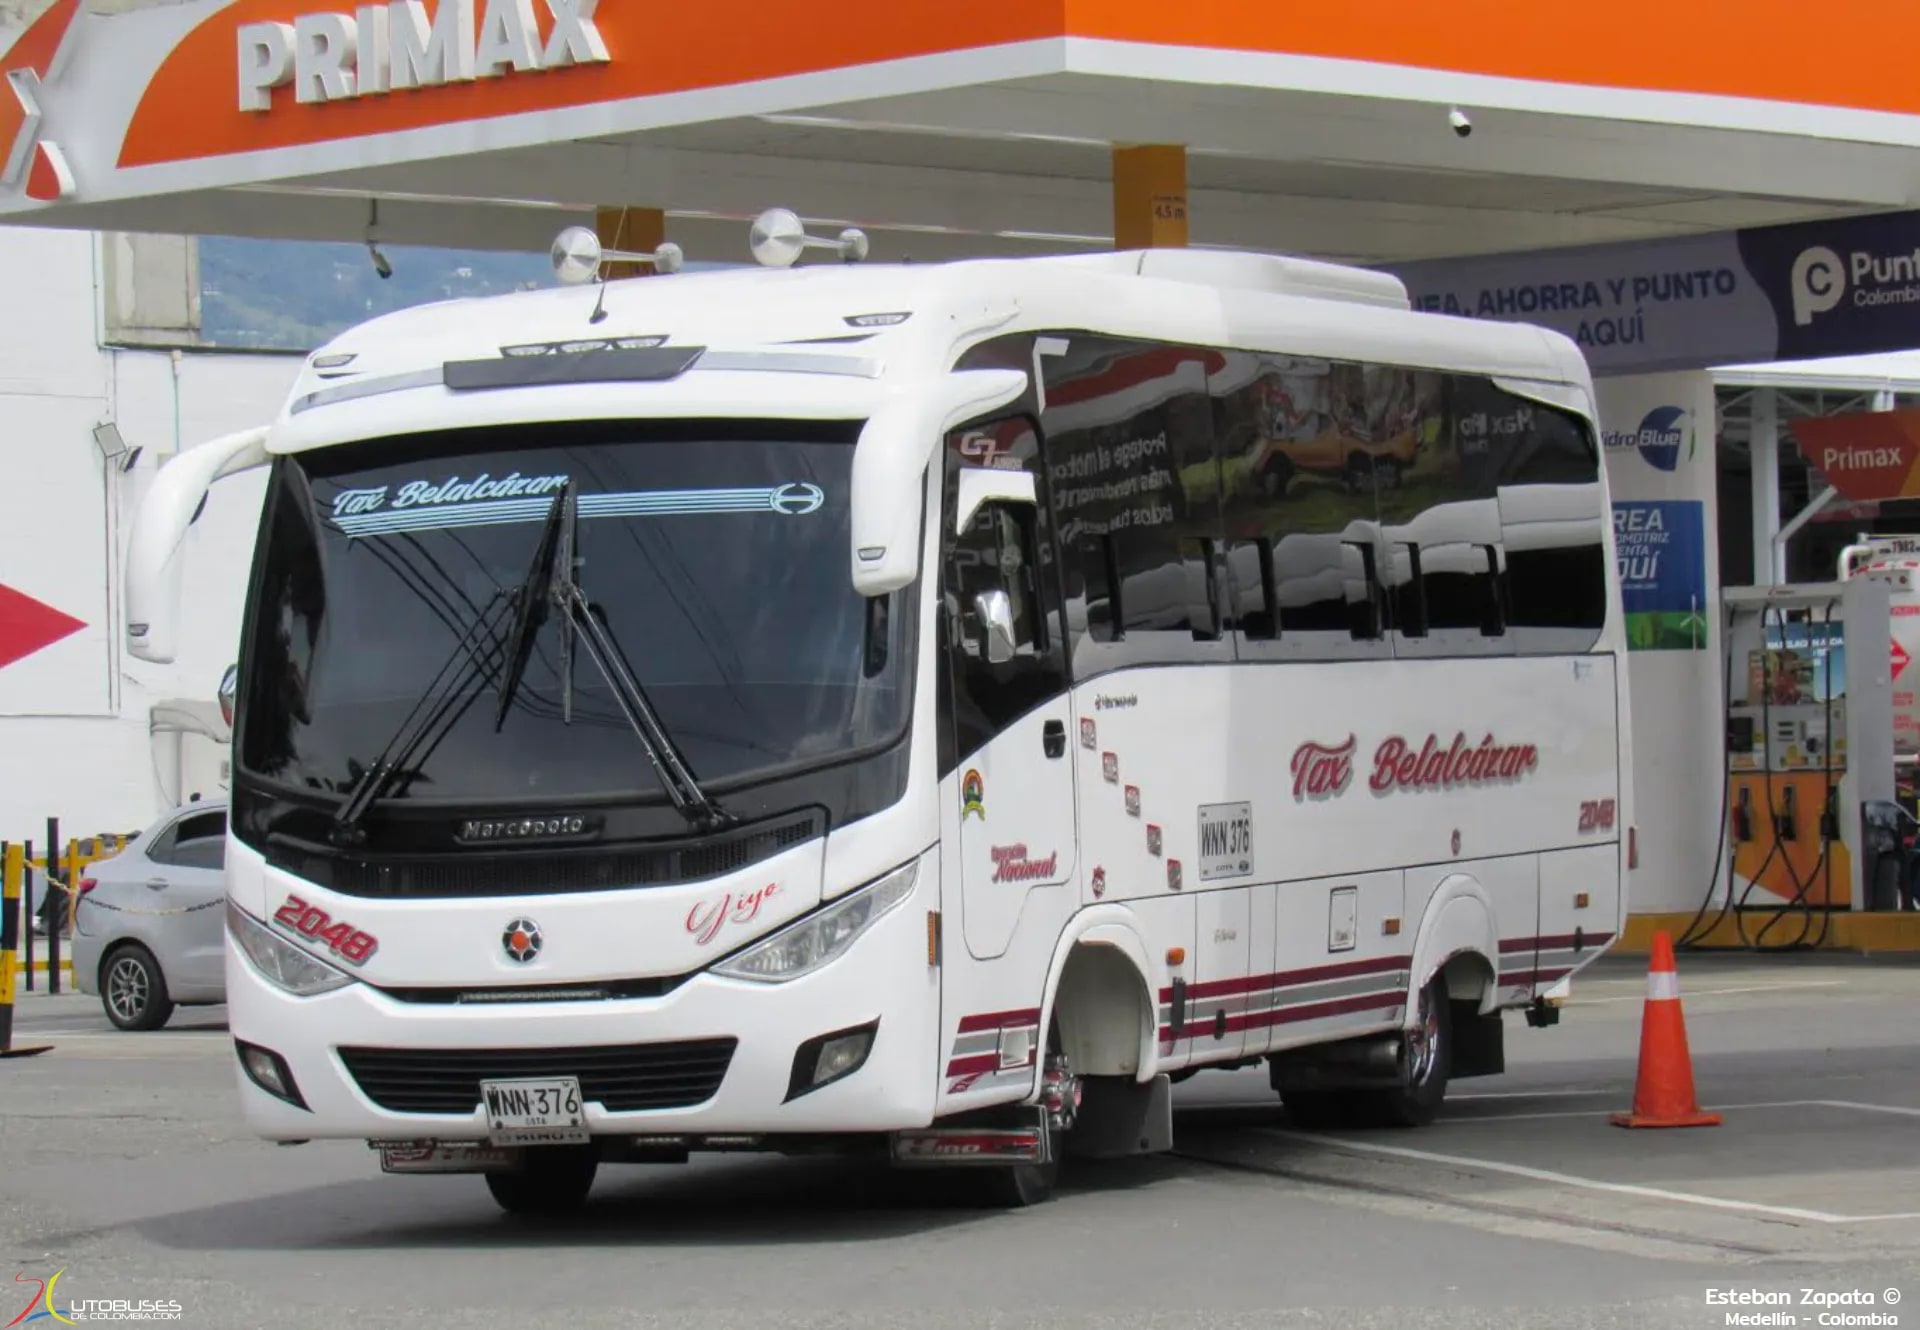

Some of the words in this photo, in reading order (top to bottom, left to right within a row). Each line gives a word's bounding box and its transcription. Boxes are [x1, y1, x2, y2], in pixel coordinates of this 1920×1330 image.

[238, 0, 612, 112] PRIMAX
[1478, 282, 1601, 316] AHORRA
[1606, 278, 1627, 305] Y
[1634, 267, 1736, 303] PUNTO
[1576, 308, 1645, 348] AQUÍ
[1823, 445, 1902, 472] Primax
[332, 485, 387, 517] Tax
[392, 472, 569, 509] Belalcázar
[1290, 731, 1357, 802] Tax
[1369, 730, 1539, 798] Belalcázar
[464, 816, 585, 839] Marcopolo
[1201, 821, 1228, 857] WNN
[1229, 817, 1250, 855] 376
[273, 893, 379, 967] 2048
